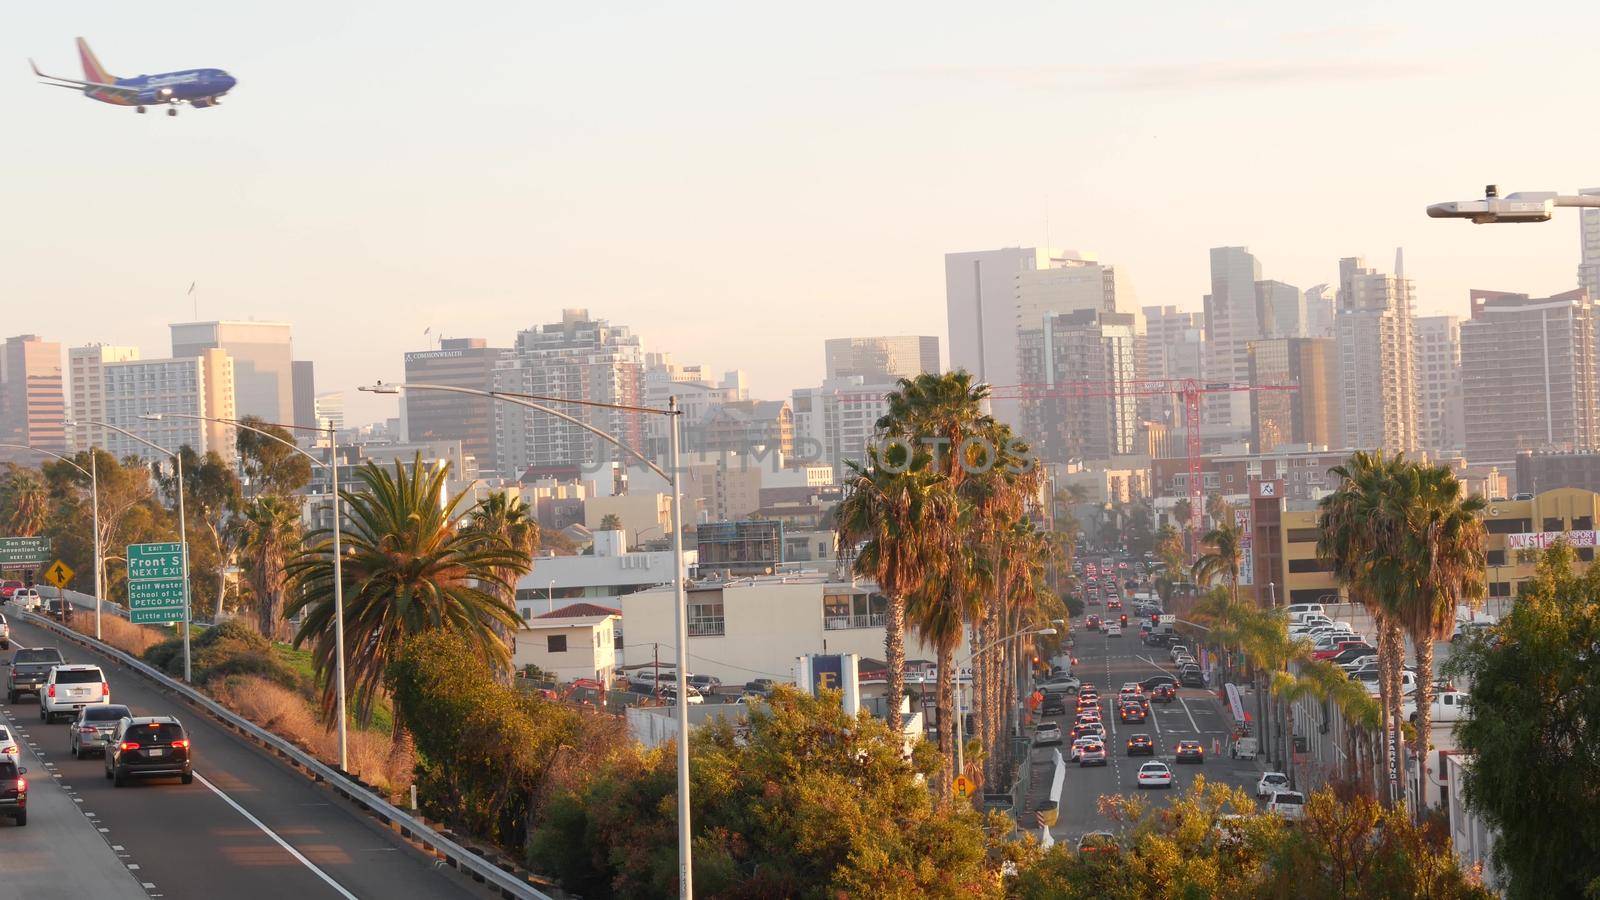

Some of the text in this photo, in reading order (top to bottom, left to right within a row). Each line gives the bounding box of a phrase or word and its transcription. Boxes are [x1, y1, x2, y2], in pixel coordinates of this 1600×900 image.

[413, 351, 463, 359] COMMONWEALTH
[1509, 535, 1527, 548] ONLY
[130, 557, 166, 568] Front
[131, 591, 158, 599] School
